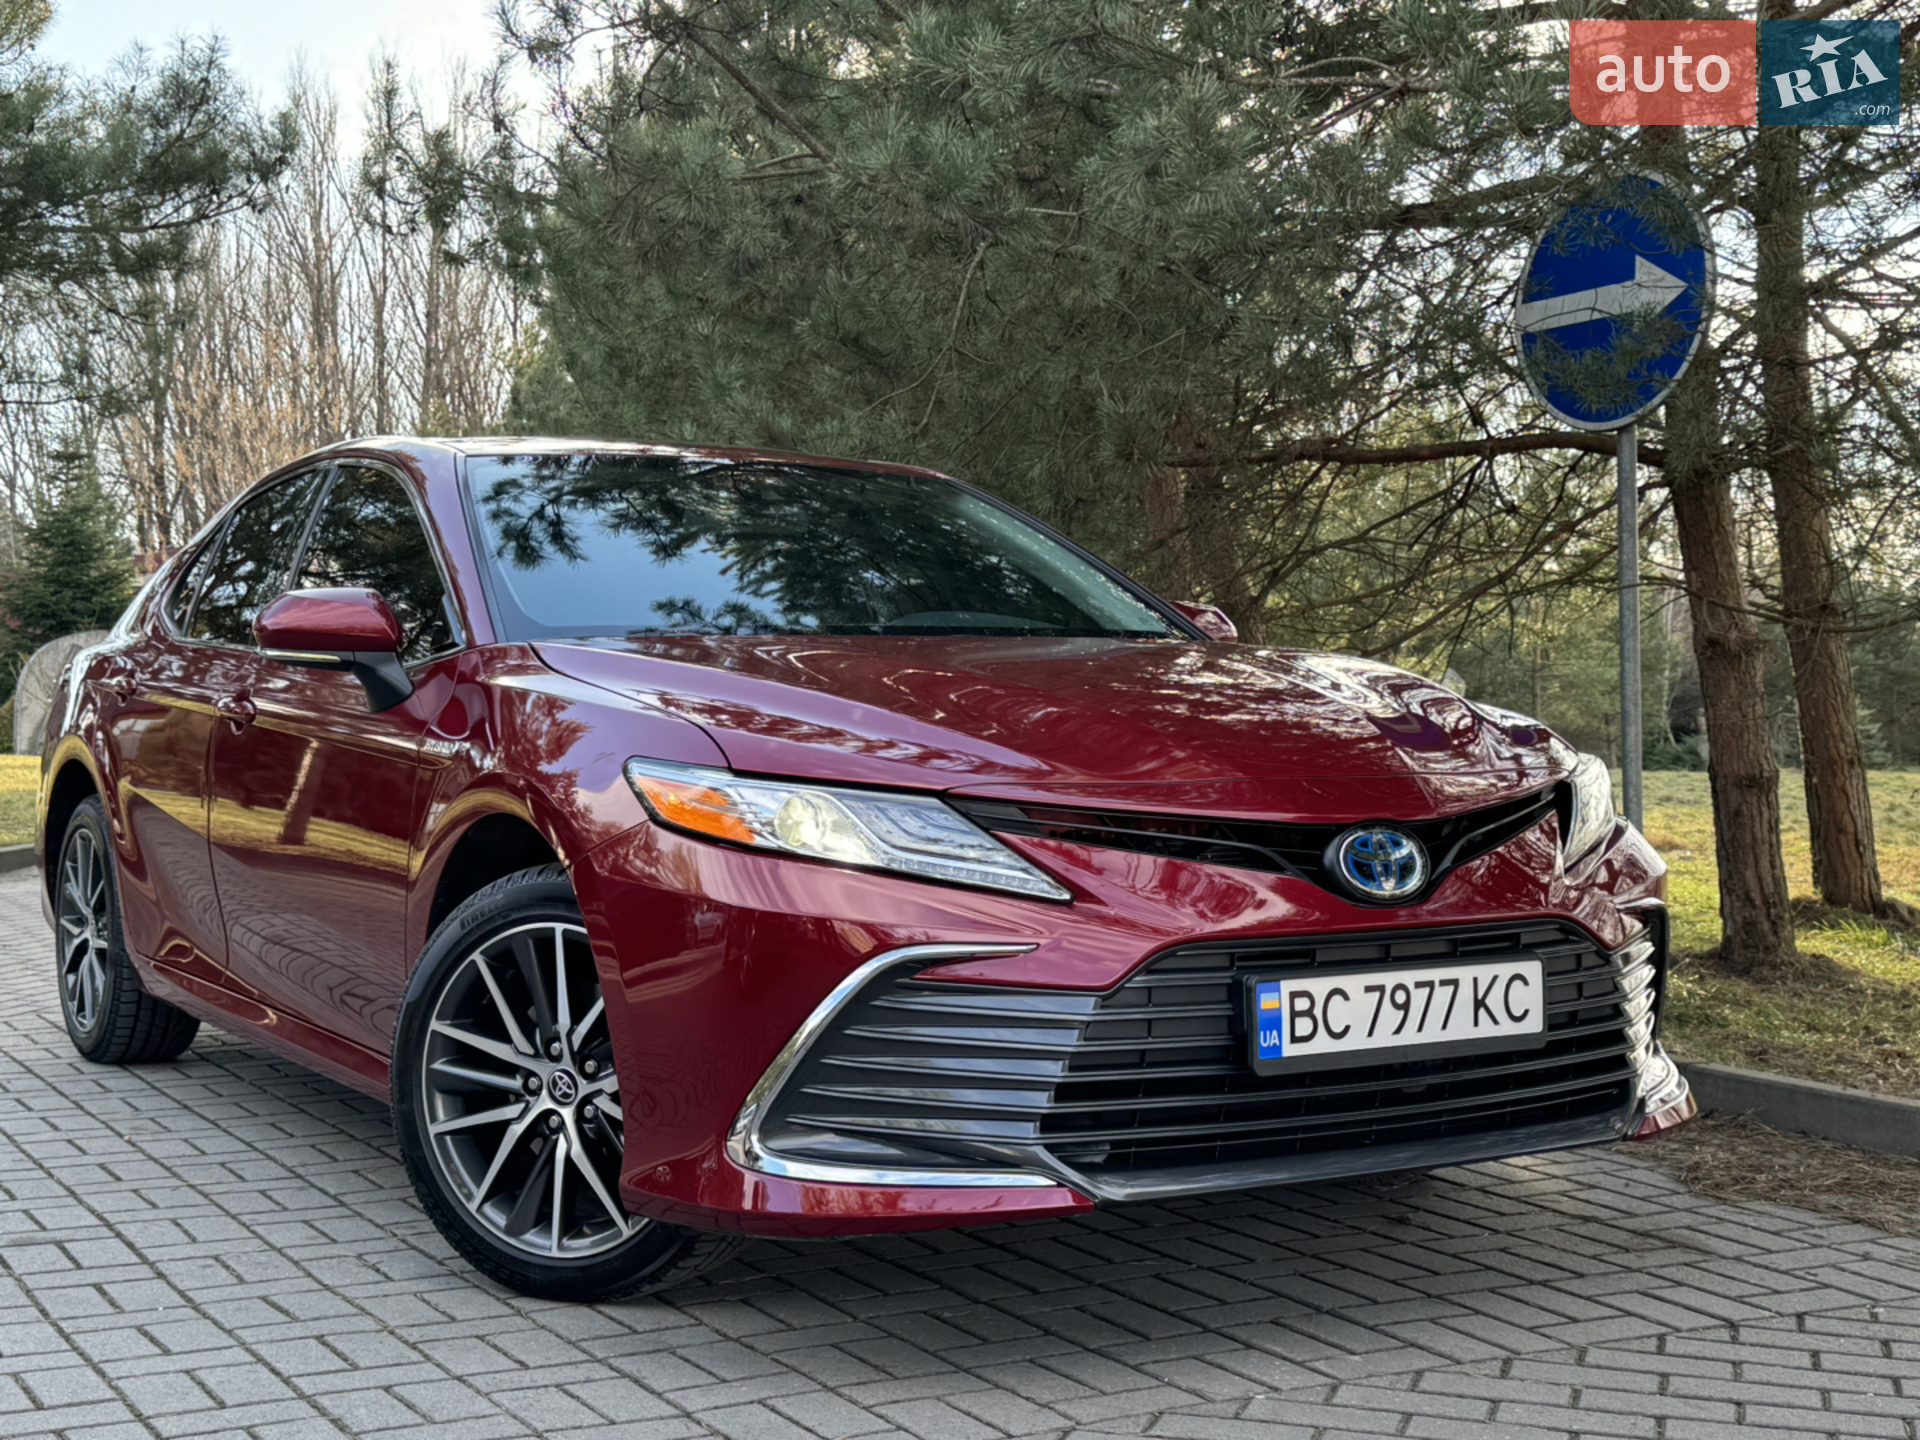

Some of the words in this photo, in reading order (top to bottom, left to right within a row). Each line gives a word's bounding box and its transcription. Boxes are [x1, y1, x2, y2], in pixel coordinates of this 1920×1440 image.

[1288, 987, 1352, 1045] BC
[1363, 978, 1460, 1038] 7977
[1472, 972, 1531, 1028] KC
[1259, 1029, 1281, 1048] UA
